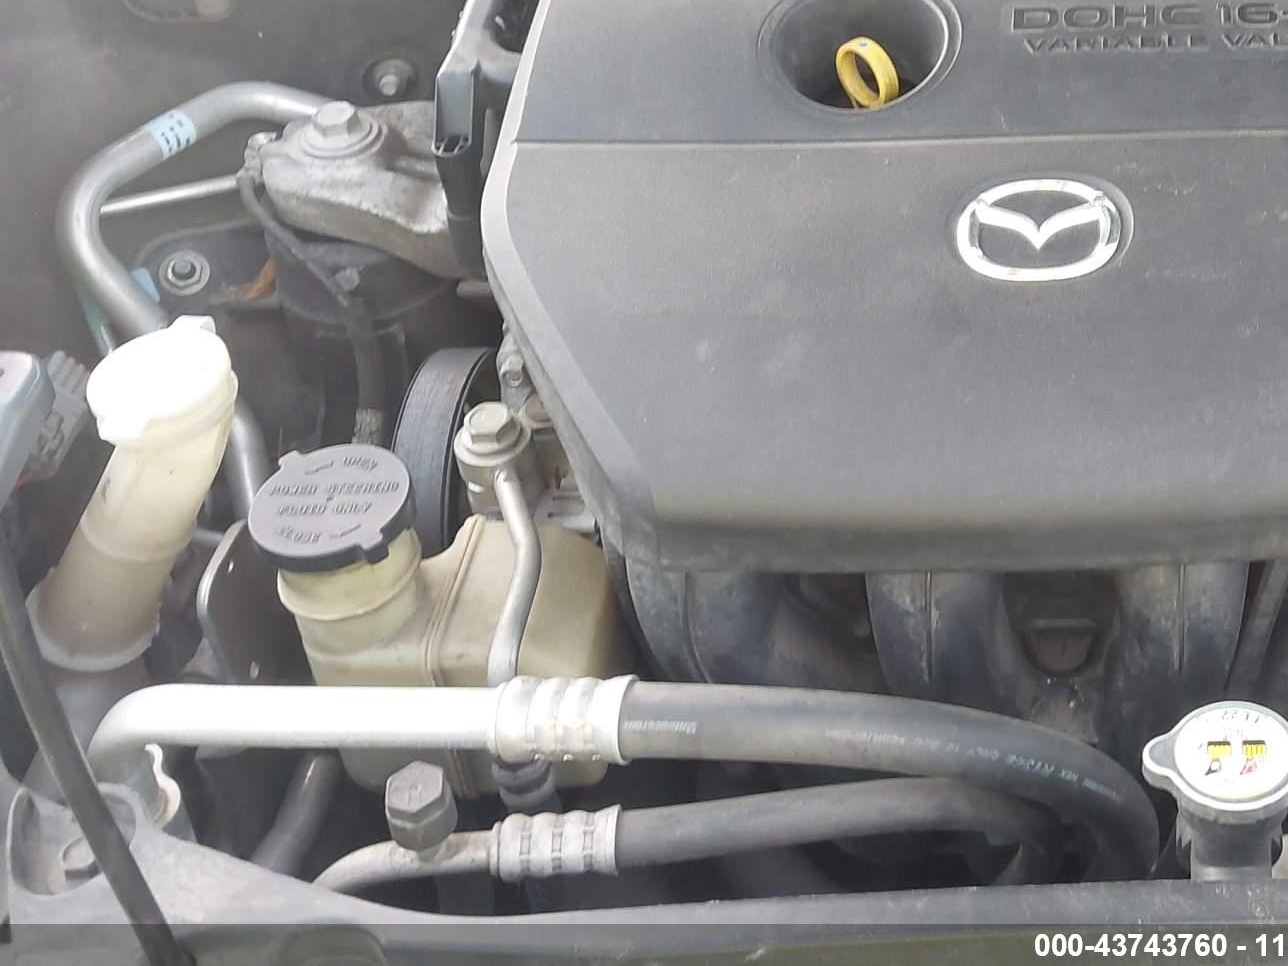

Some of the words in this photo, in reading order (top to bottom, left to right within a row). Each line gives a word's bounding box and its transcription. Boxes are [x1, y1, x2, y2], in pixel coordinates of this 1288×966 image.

[1011, 4, 1202, 34] DOHC
[1022, 34, 1209, 55] VARIABLE
[332, 502, 373, 515] ONLY
